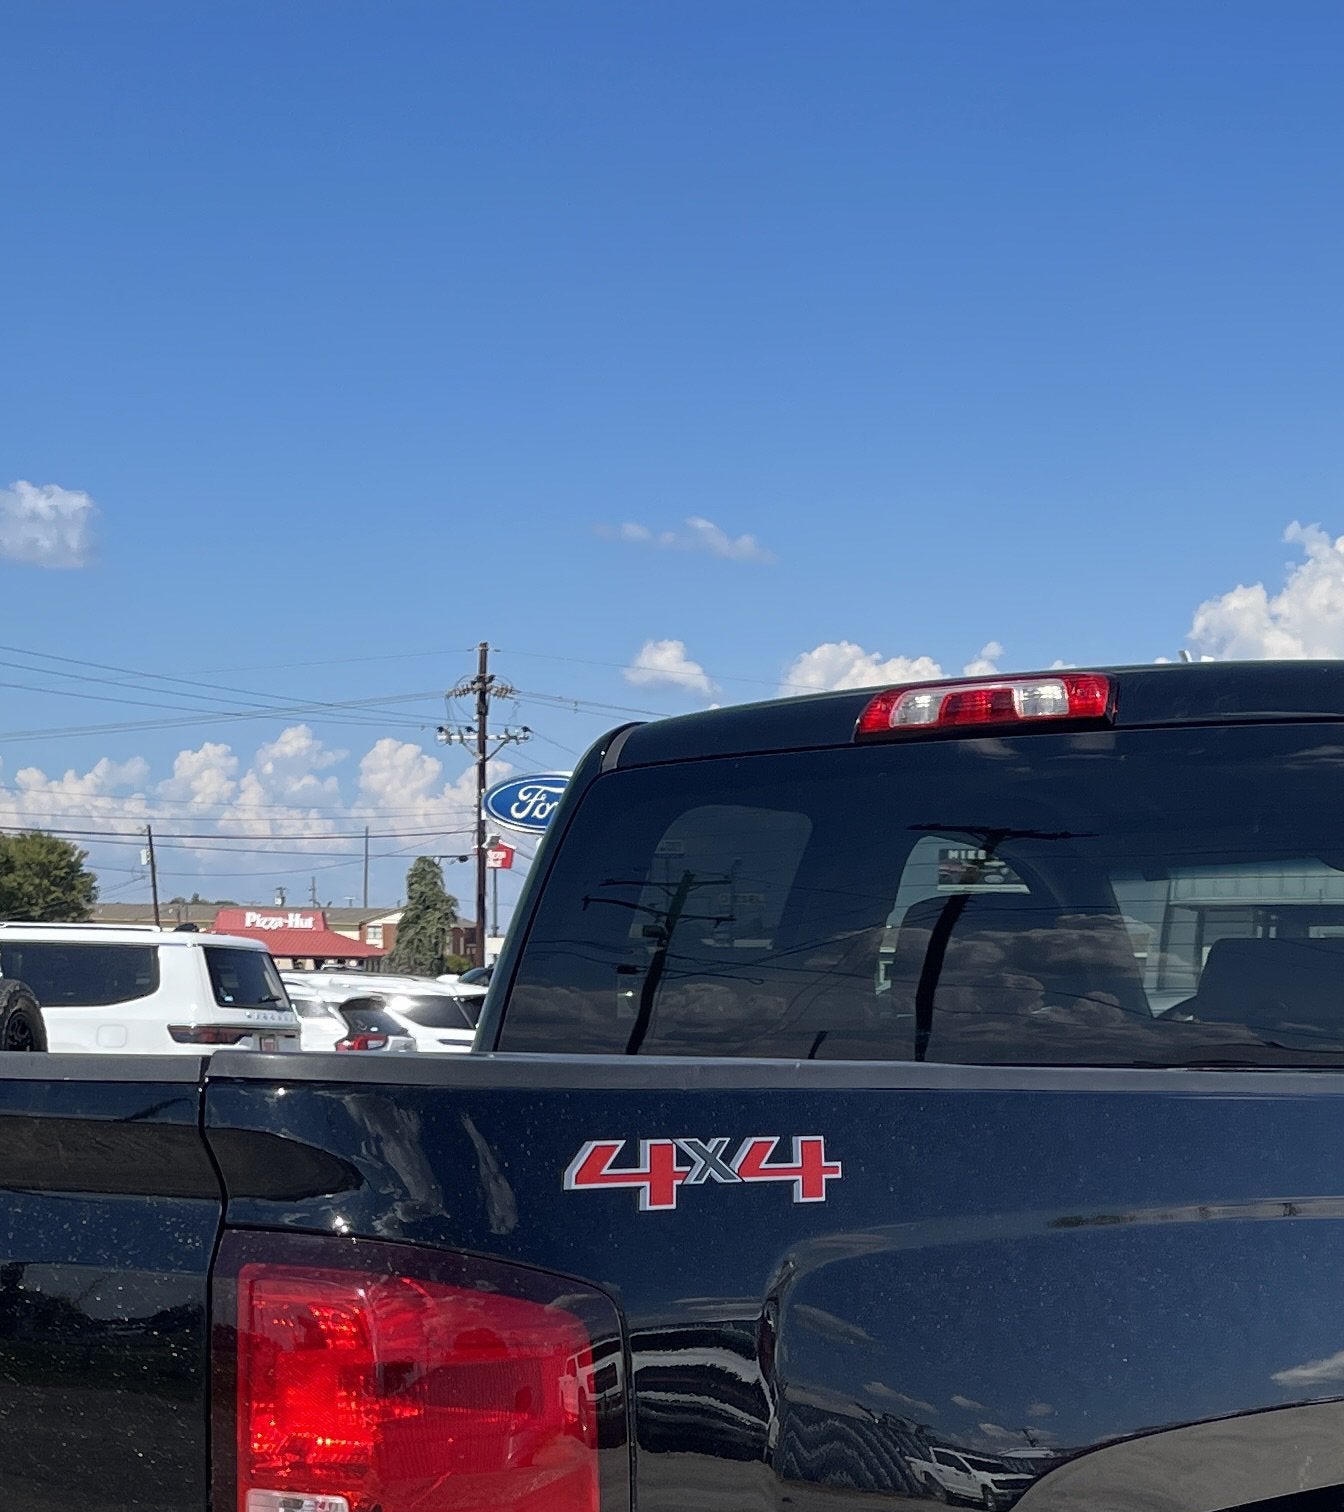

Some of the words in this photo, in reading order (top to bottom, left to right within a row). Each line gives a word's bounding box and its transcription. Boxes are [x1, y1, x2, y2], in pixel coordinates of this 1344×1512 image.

[511, 785, 565, 819] Fo
[245, 912, 285, 930] Pizza
[287, 913, 316, 929] Hut
